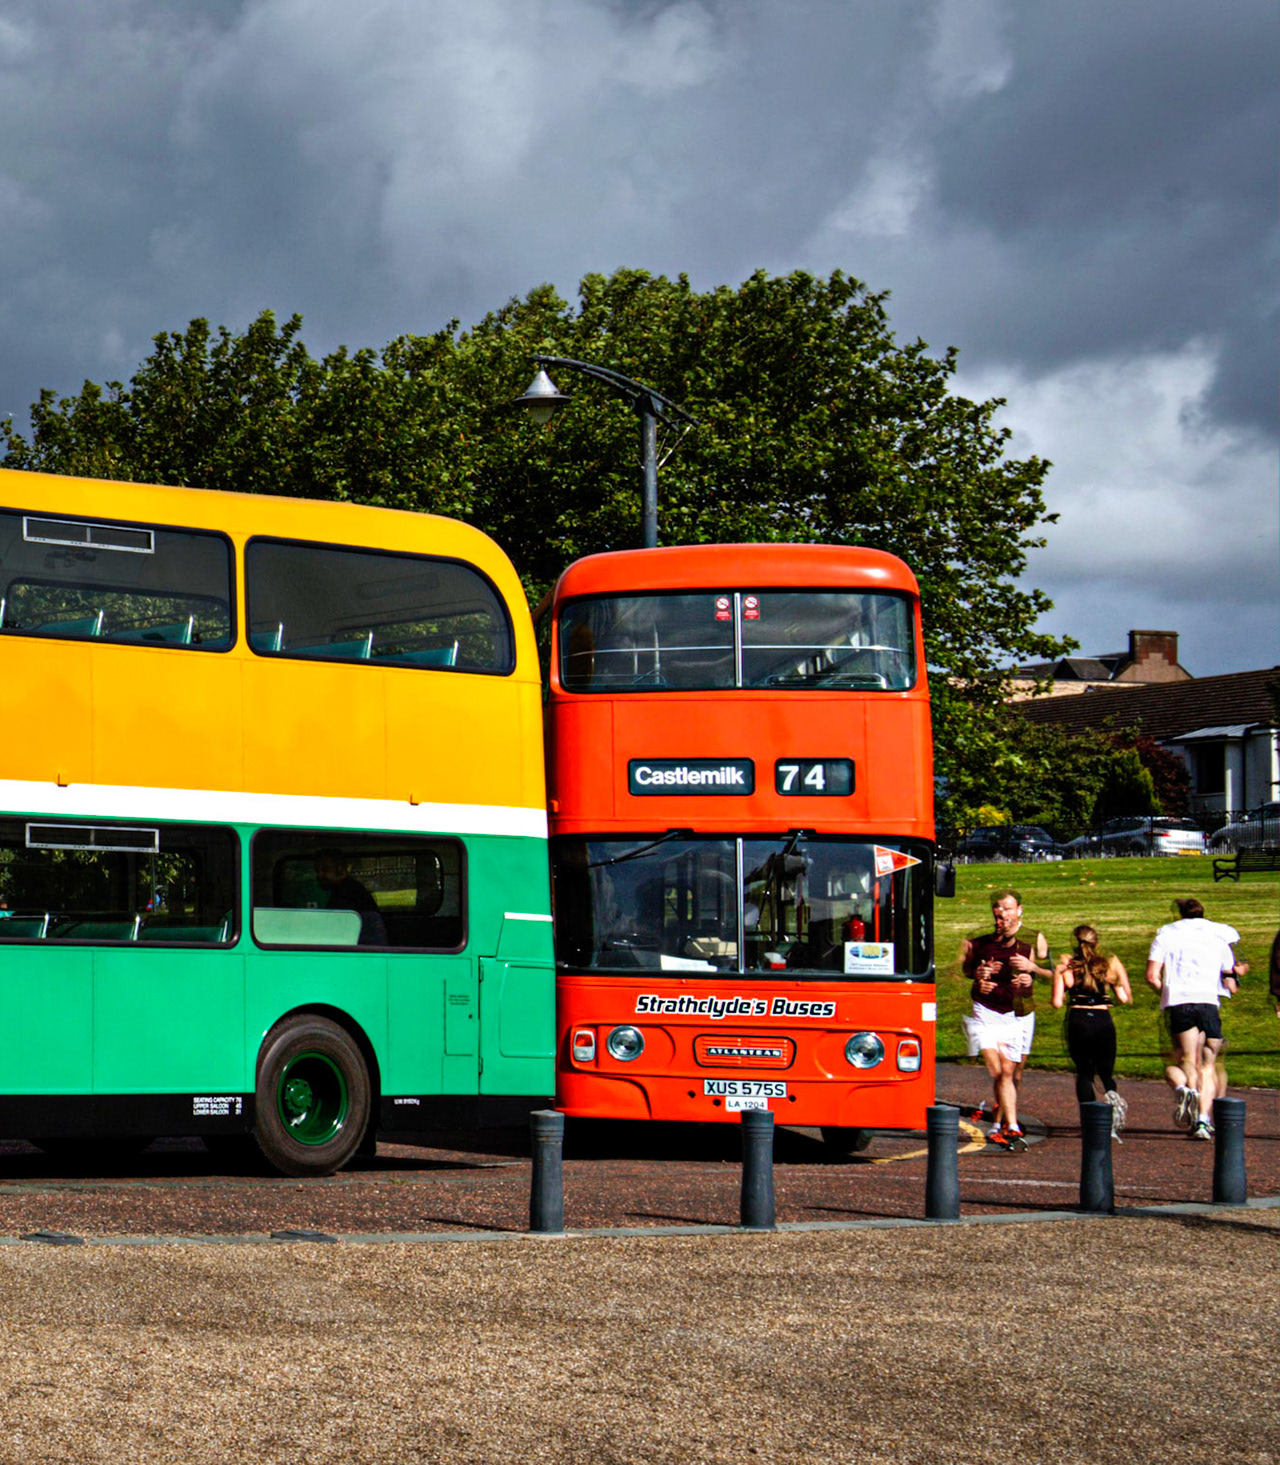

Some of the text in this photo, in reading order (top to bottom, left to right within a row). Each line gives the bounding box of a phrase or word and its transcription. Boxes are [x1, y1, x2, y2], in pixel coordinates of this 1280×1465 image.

[635, 766, 744, 785] Castlemilk
[778, 764, 826, 791] 74
[636, 995, 836, 1019] Strathclyde's Buses
[709, 1048, 781, 1057] ATLANTEAN
[706, 1081, 785, 1097] XUS 575S
[728, 1101, 765, 1109] LA 1204
